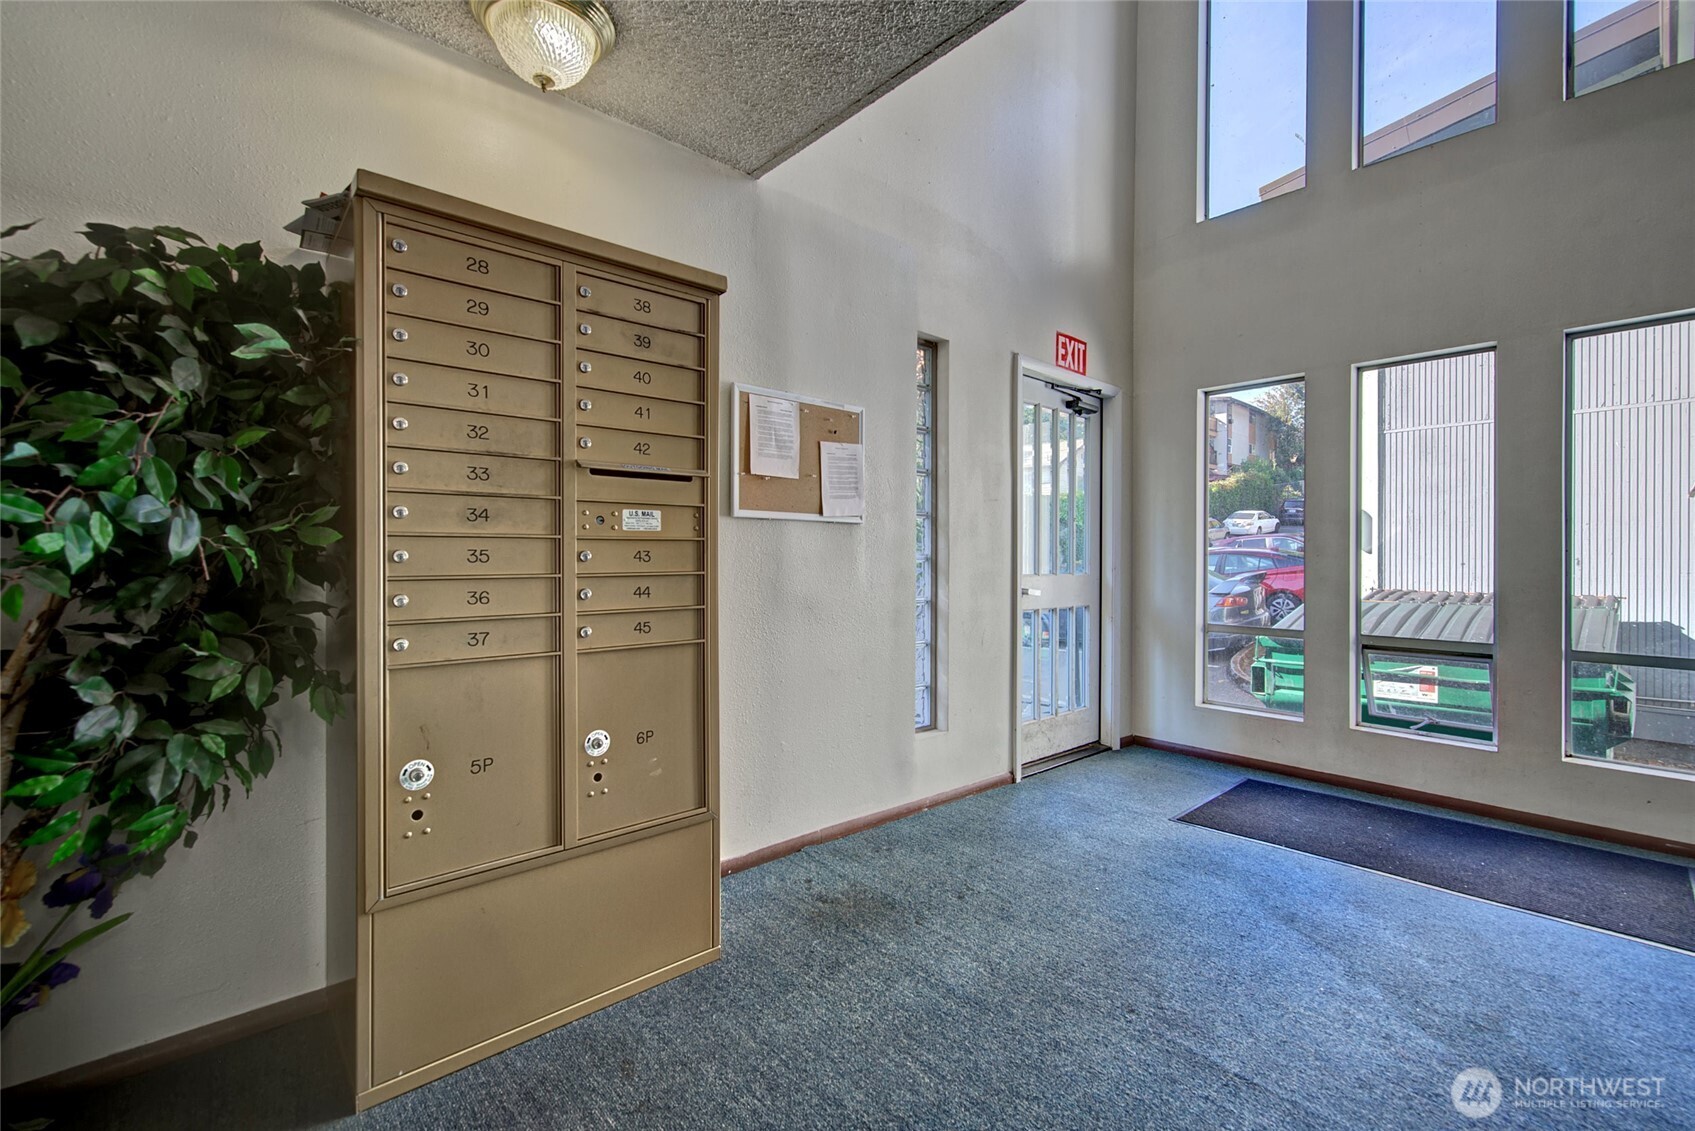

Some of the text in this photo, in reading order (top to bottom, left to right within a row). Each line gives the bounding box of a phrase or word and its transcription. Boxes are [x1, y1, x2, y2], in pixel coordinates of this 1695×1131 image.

[466, 256, 490, 275] 28
[466, 299, 490, 316] 29
[633, 298, 652, 314] 38
[466, 340, 490, 358] 30
[633, 334, 652, 349] 39
[1058, 335, 1085, 373] EXIT
[633, 371, 652, 385] 40
[467, 382, 489, 399] 31
[634, 406, 651, 420] 41
[466, 424, 490, 441] 32
[633, 442, 651, 456] 42
[466, 465, 491, 482] 33
[466, 507, 491, 523] 34
[466, 548, 491, 564] 35
[633, 549, 652, 563] 43
[466, 590, 491, 606] 36
[633, 585, 652, 599] 44
[633, 620, 652, 635] 45
[466, 631, 490, 647] 37
[636, 730, 655, 745] 6P
[408, 761, 426, 770] OPEN
[469, 757, 494, 775] 5P
